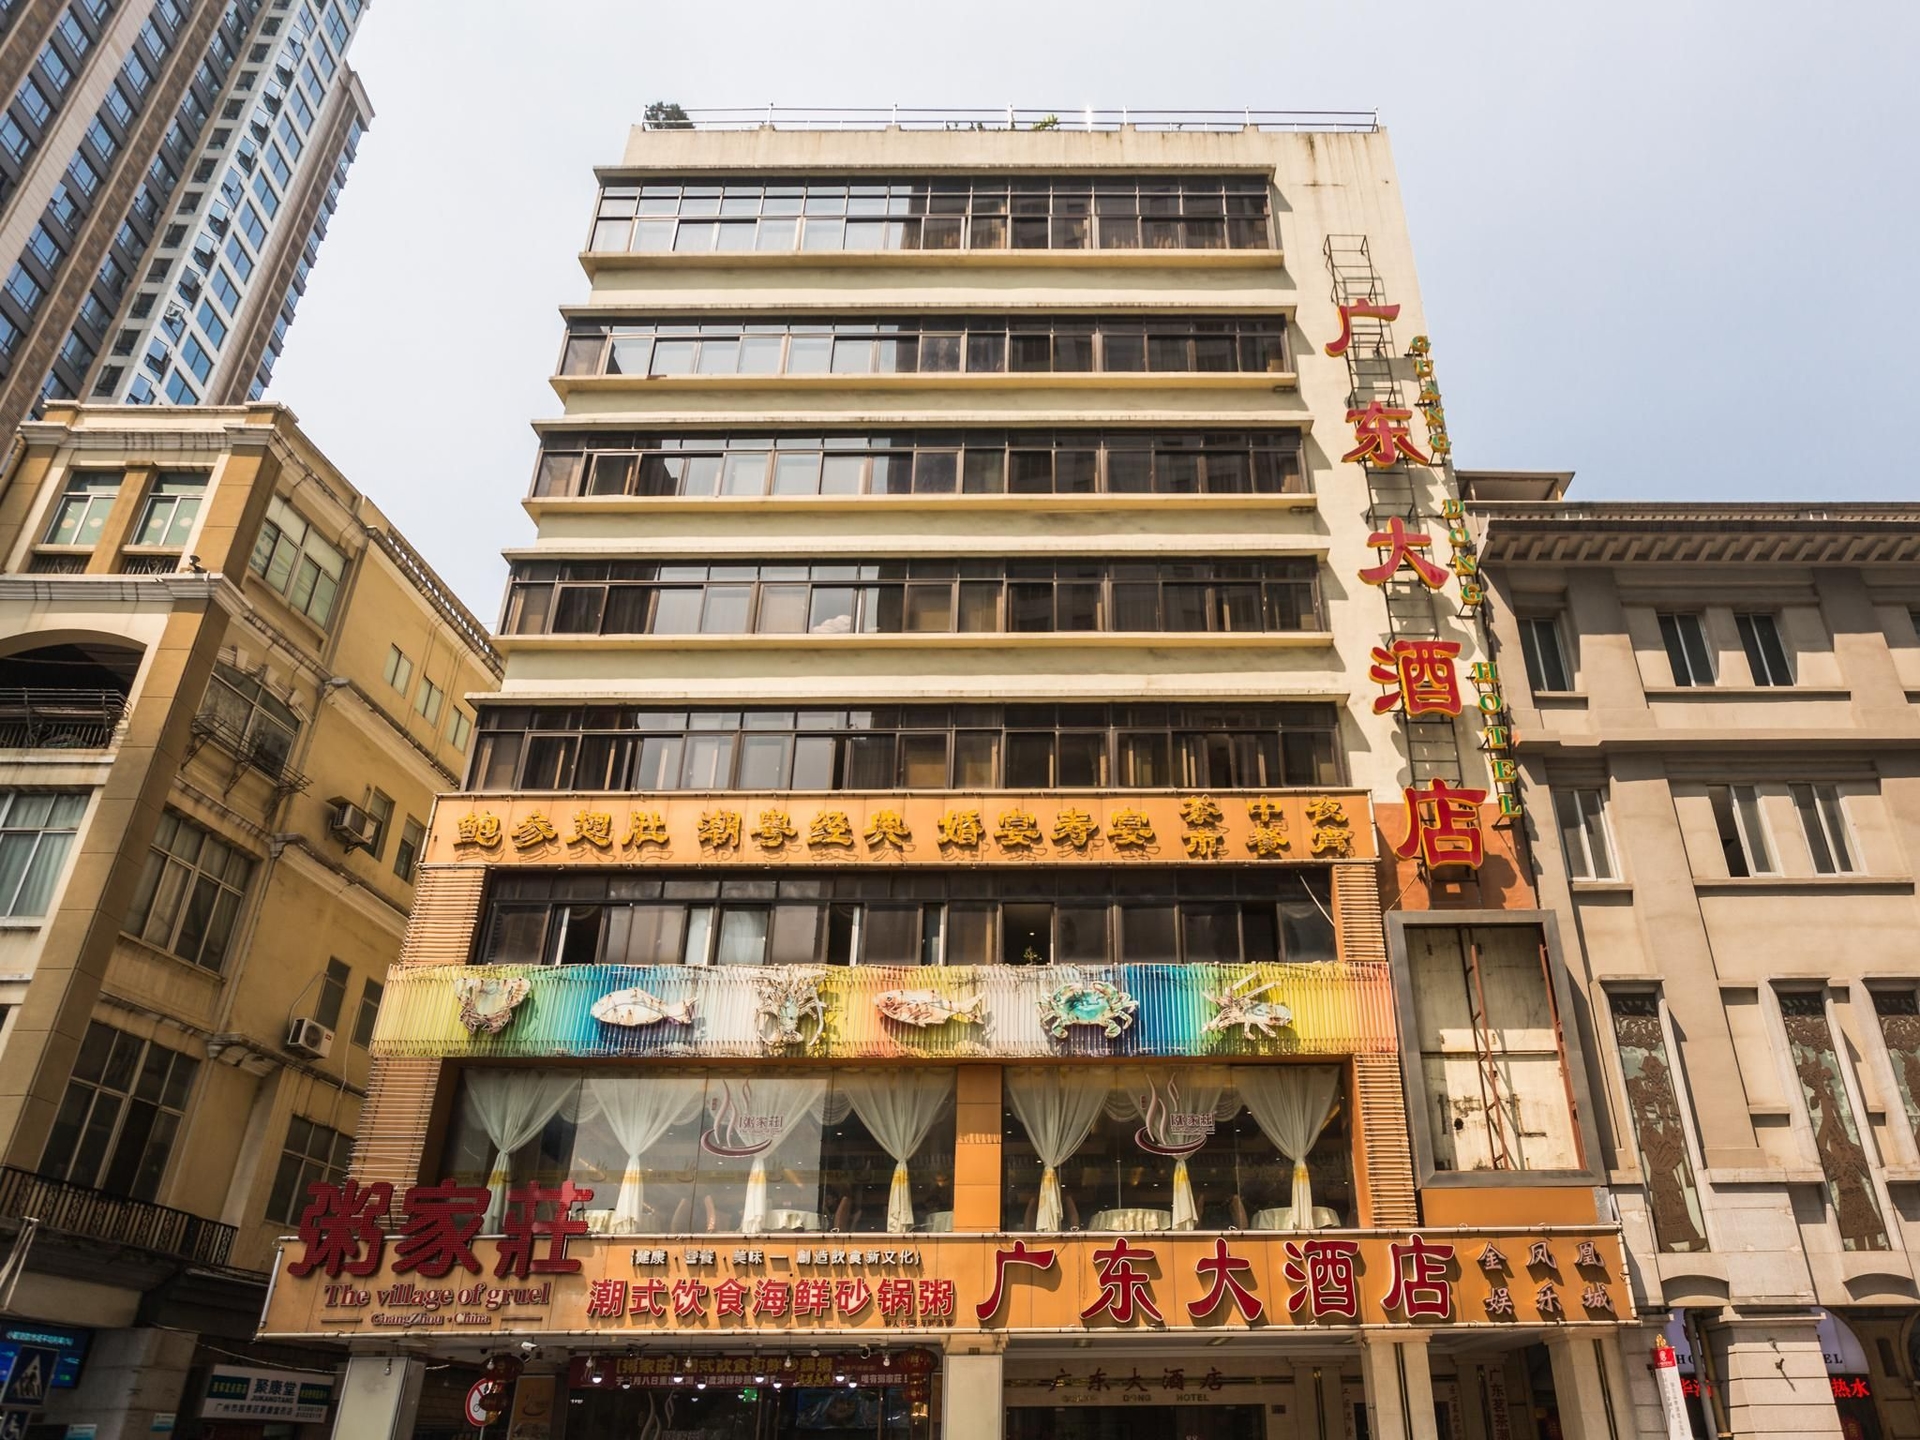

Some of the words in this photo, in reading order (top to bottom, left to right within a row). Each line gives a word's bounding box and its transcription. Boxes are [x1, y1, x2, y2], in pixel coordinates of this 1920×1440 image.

[1325, 298, 1488, 869] 广东大酒店
[1410, 335, 1452, 453] GUANG
[1442, 499, 1484, 606] DONG
[1471, 662, 1522, 818] HOTEL
[287, 1178, 594, 1279] 粥家莊
[1475, 1240, 1607, 1271] 金凤凰
[975, 1232, 1456, 1324] 广东大酒店
[324, 1283, 370, 1307] The
[376, 1282, 453, 1311] village
[457, 1281, 487, 1306] of
[485, 1281, 552, 1309] gruel
[586, 1276, 956, 1319] 潮式饮食海鲜砂锅粥
[1482, 1281, 1616, 1316] 娱乐城
[1048, 1366, 1226, 1393] 广东大酒店
[1831, 1377, 1871, 1399] 热水
[1176, 1393, 1210, 1402] HOTEL
